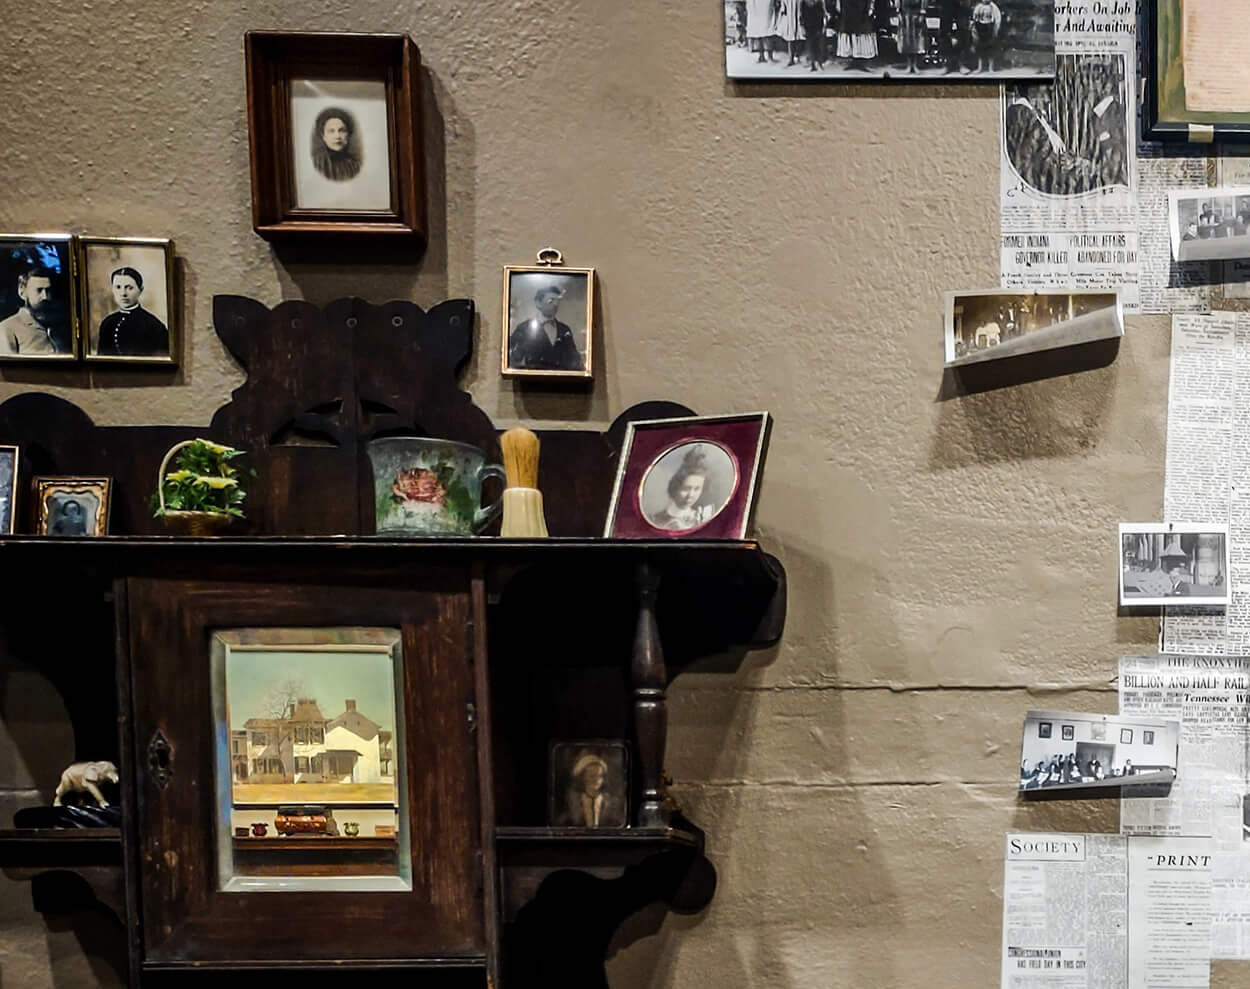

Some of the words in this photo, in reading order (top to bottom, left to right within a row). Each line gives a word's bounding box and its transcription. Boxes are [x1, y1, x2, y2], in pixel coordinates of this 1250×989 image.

[1093, 2, 1107, 15] On
[1112, 1, 1130, 15] Job
[1063, 18, 1085, 32] And
[1087, 19, 1136, 35] Awaiting
[1124, 675, 1164, 688] BILLION
[1168, 676, 1190, 689] AND
[1184, 693, 1230, 703] Tennessee
[1010, 838, 1081, 855] SOCIETY
[1156, 855, 1211, 867] PRINT
